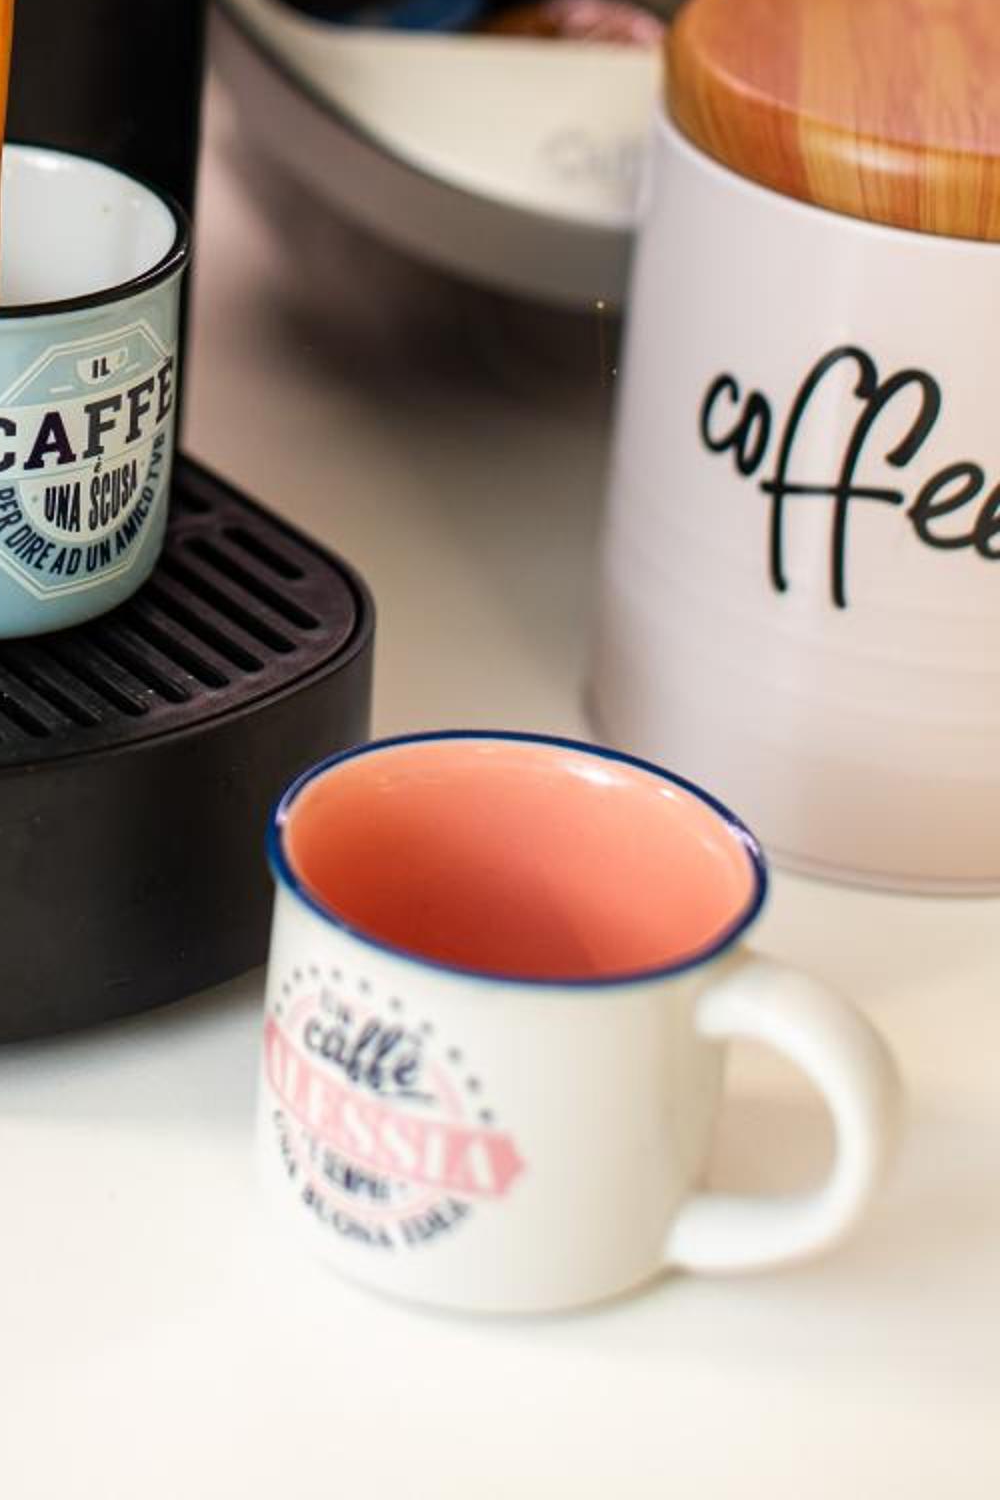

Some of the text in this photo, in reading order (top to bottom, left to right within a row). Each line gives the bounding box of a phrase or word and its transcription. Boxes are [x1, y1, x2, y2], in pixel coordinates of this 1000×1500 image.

[92, 356, 110, 379] IL
[4, 524, 56, 570] DIRE
[50, 547, 82, 576] AD
[86, 538, 111, 571] UN
[115, 485, 154, 556] AMICO
[44, 459, 137, 533] UNA SCUSA
